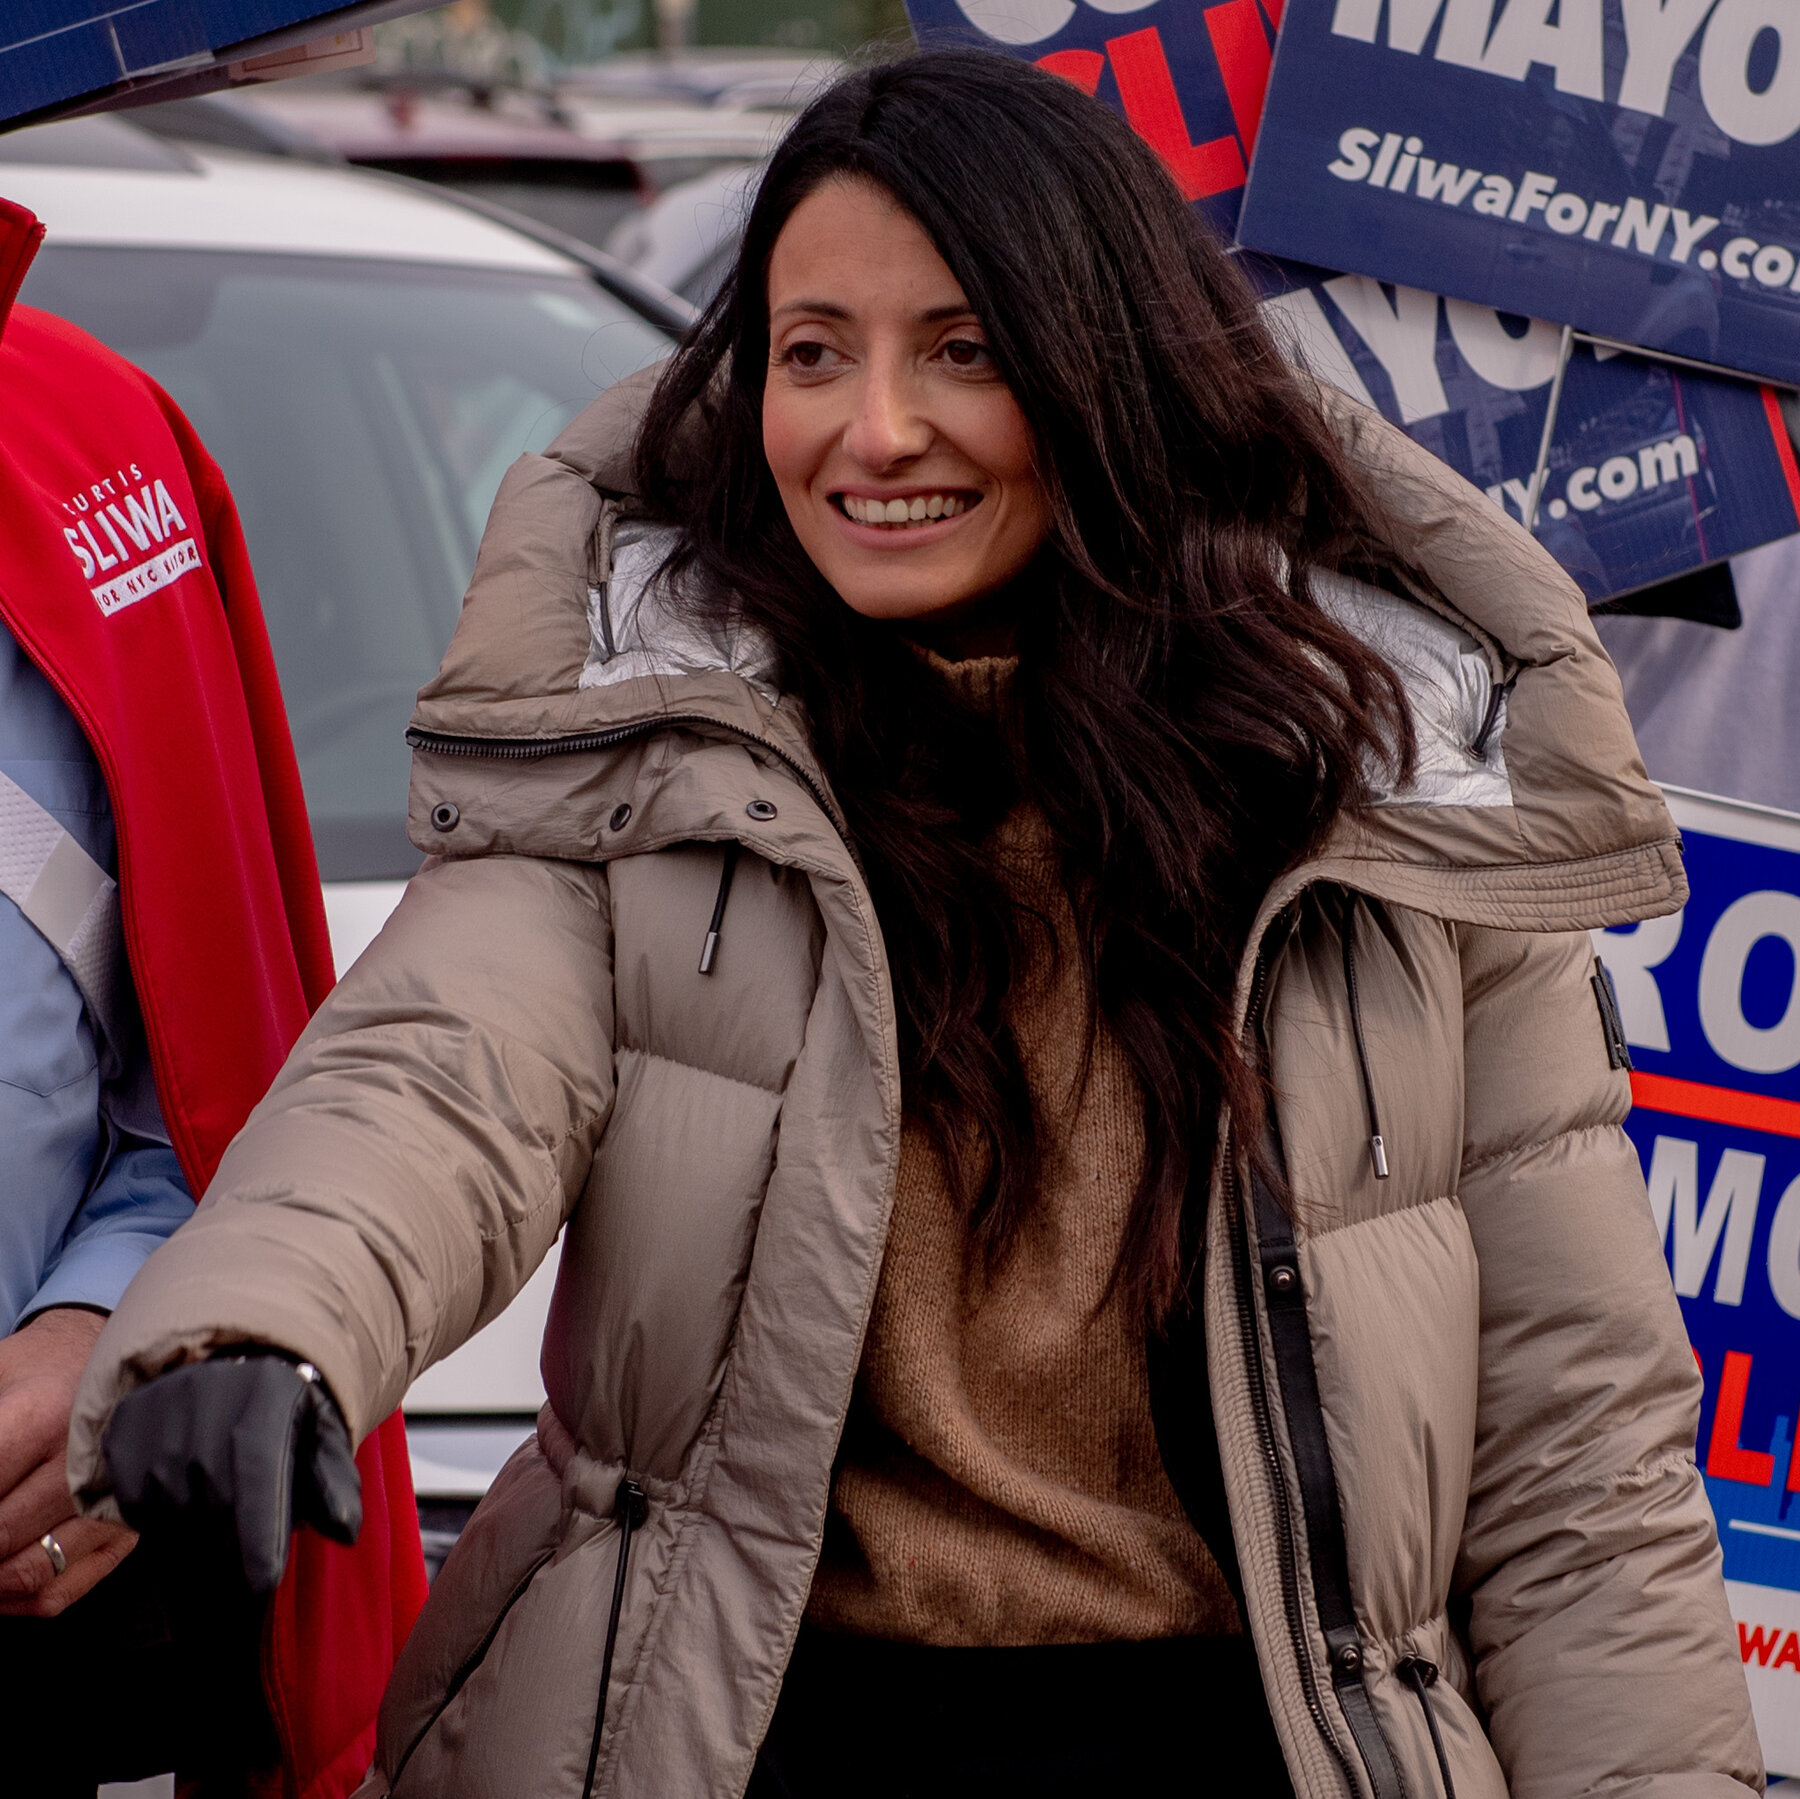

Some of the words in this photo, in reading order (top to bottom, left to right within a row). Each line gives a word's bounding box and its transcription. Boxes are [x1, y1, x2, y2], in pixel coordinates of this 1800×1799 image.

[63, 478, 187, 580] SLIWA
[96, 588, 121, 610] OR
[126, 568, 158, 596] NYC
